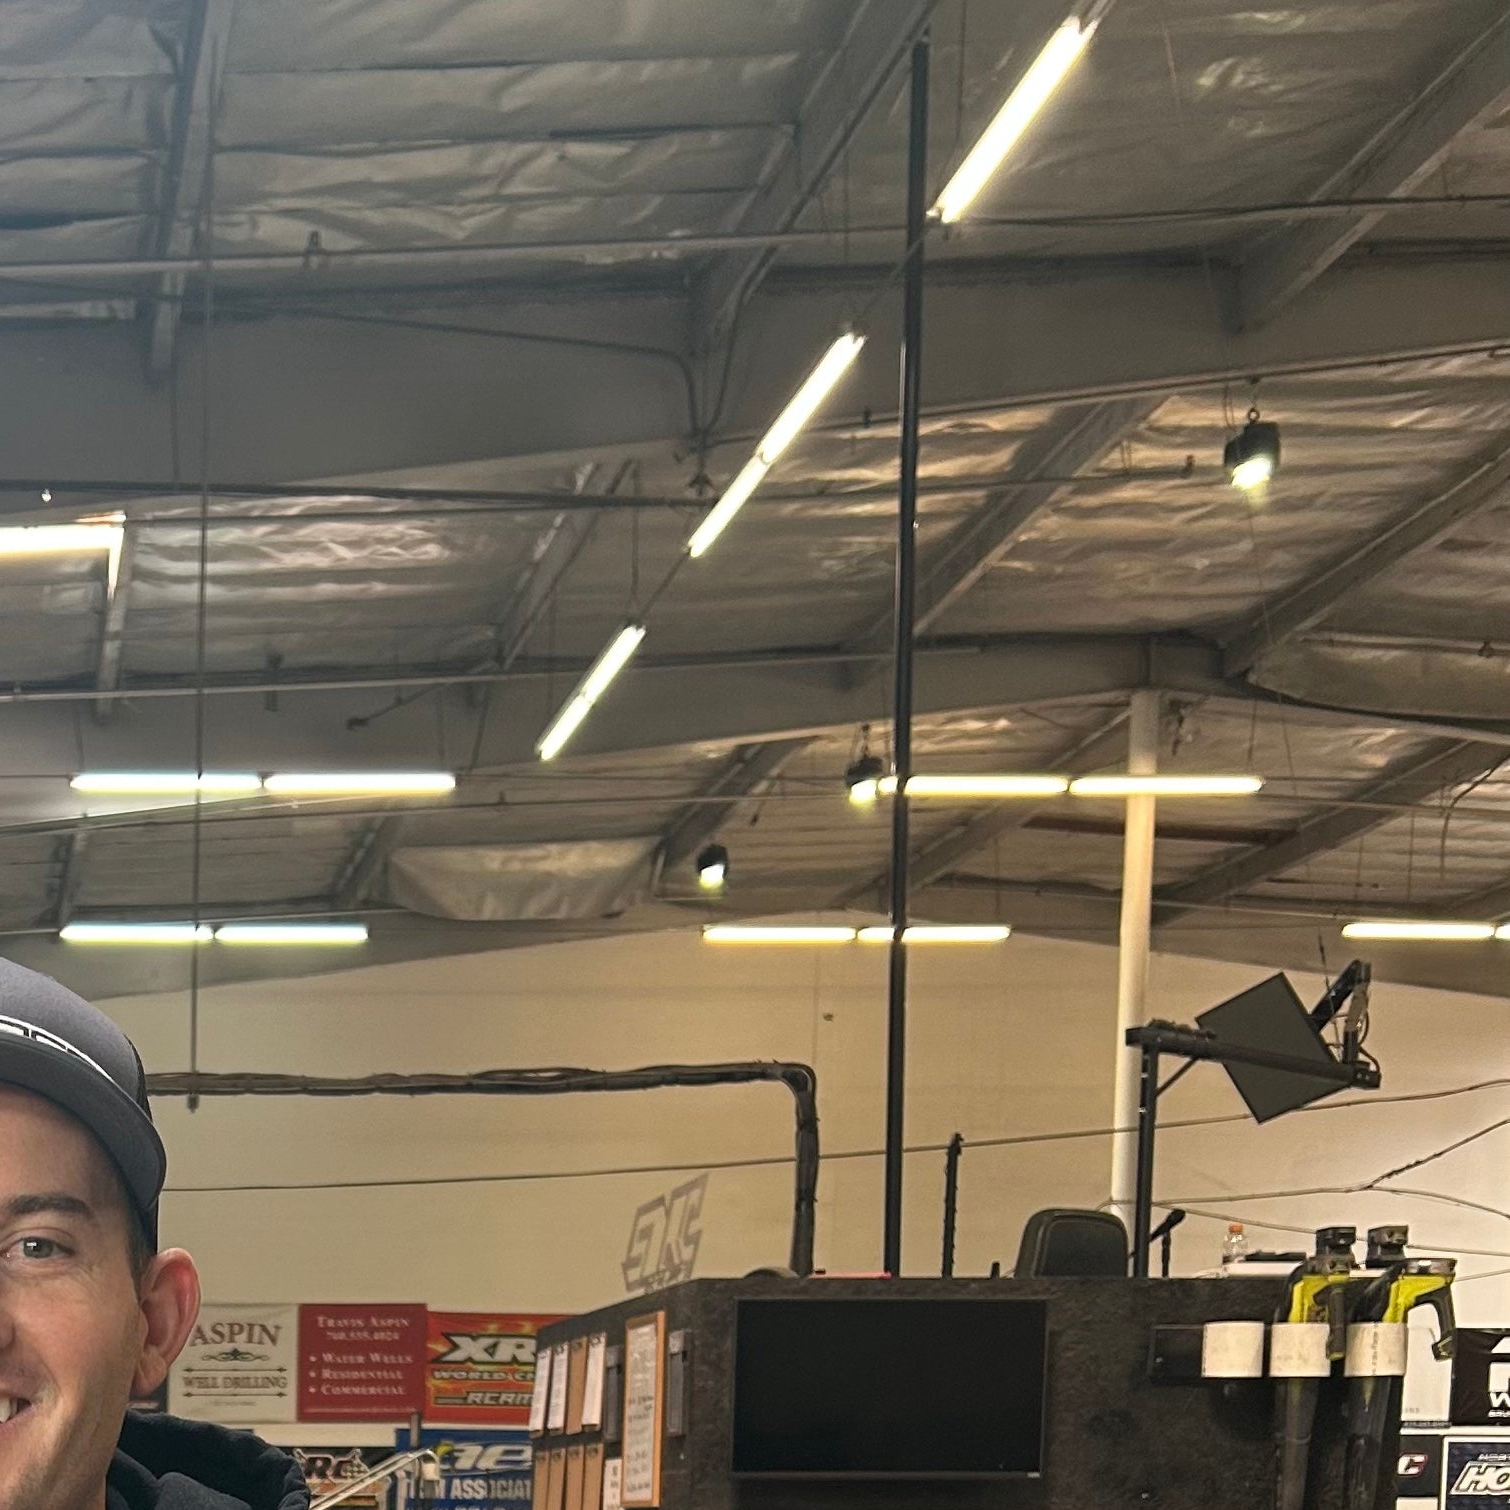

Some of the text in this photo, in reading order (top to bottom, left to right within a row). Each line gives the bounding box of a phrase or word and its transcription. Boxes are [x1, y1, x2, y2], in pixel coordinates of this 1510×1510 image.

[189, 1322, 283, 1348] ASPIN
[183, 1375, 288, 1391] WELL DRILLING
[433, 1369, 507, 1382] WORLD
